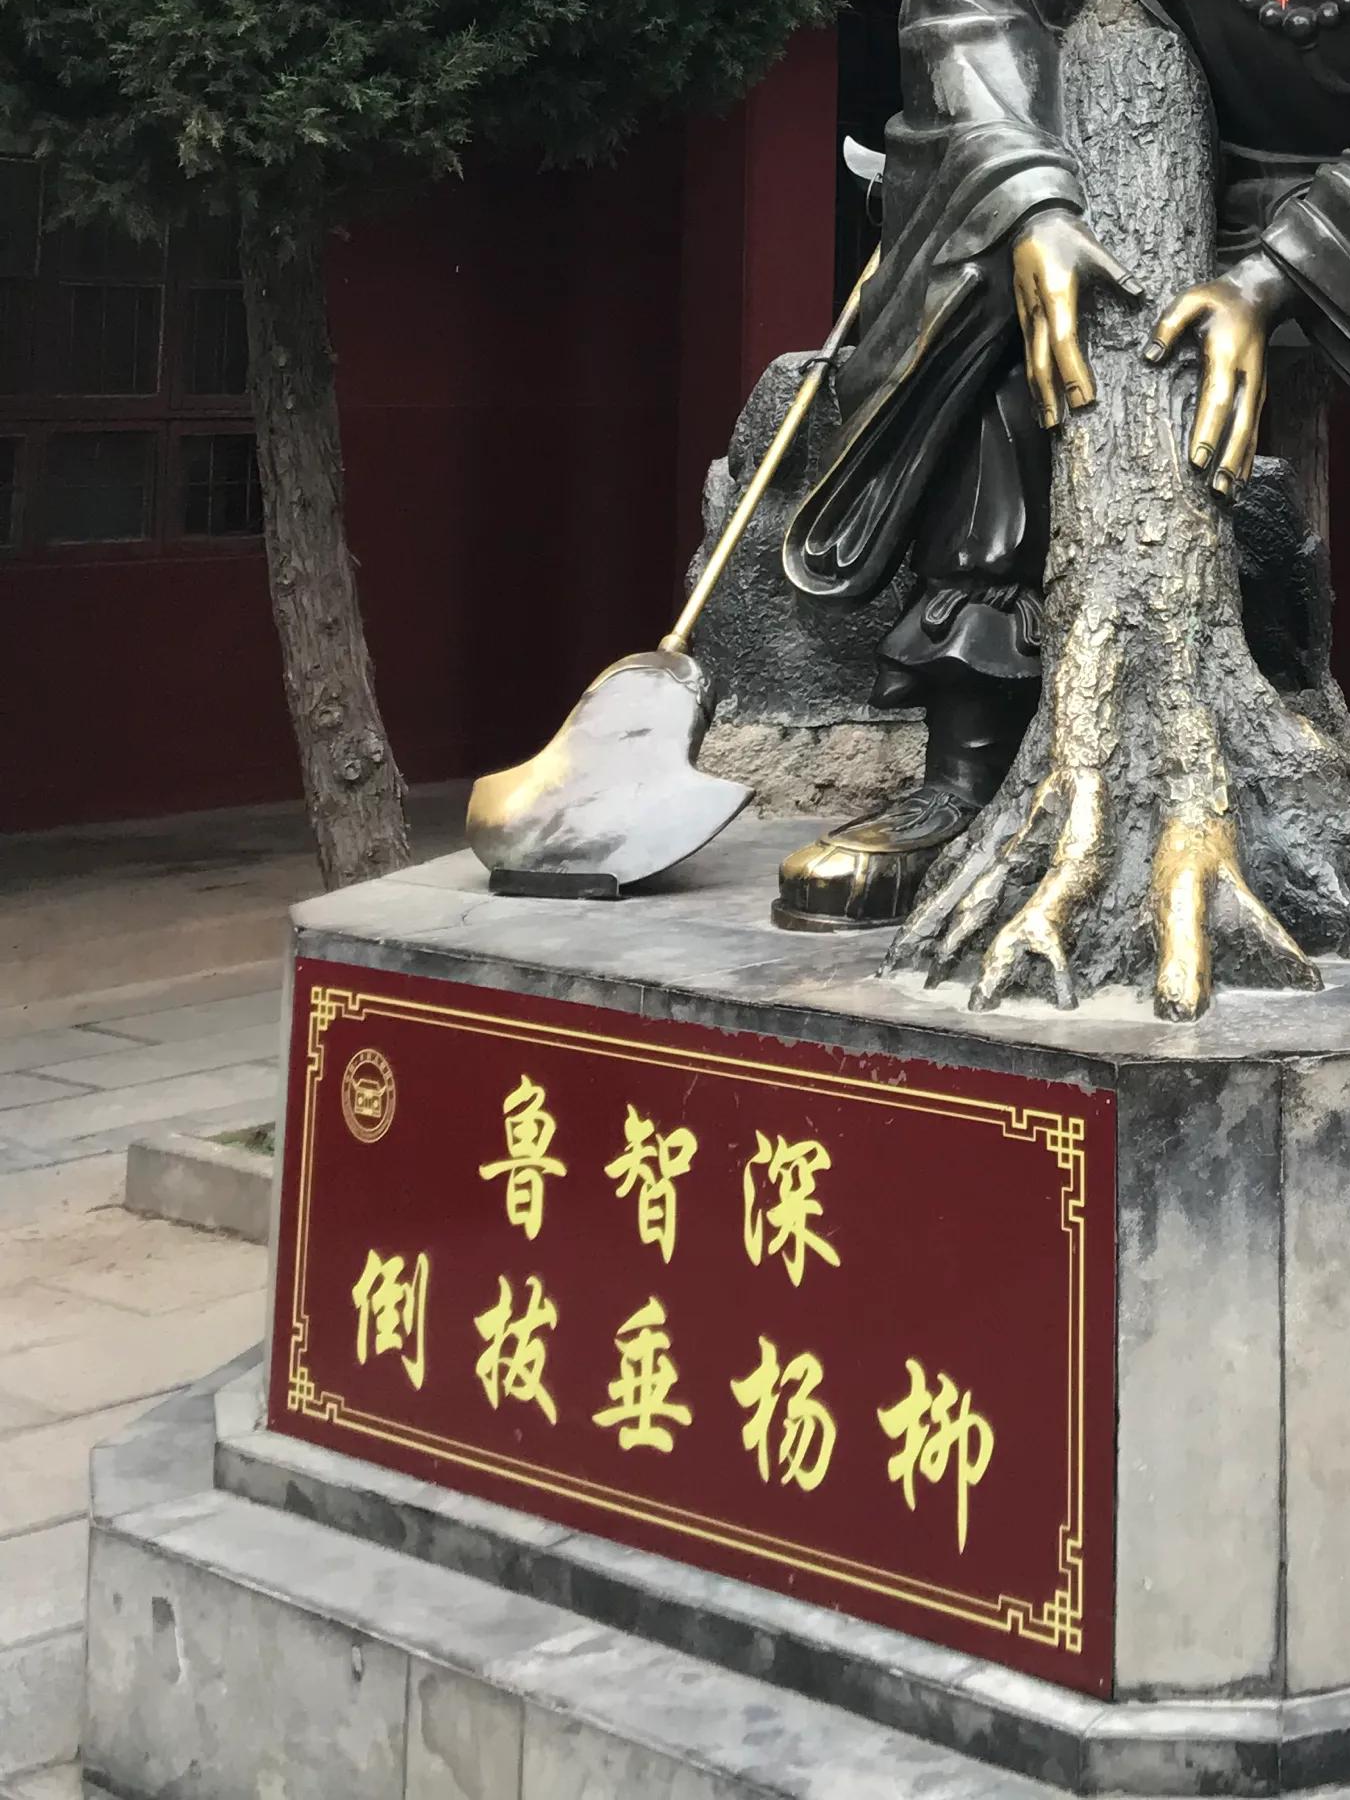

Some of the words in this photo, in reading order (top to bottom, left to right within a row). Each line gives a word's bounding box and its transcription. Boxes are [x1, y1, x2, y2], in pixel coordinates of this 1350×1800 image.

[478, 1073, 841, 1288] 鲁智深
[351, 1247, 995, 1555] 倒拔垂杨柳
